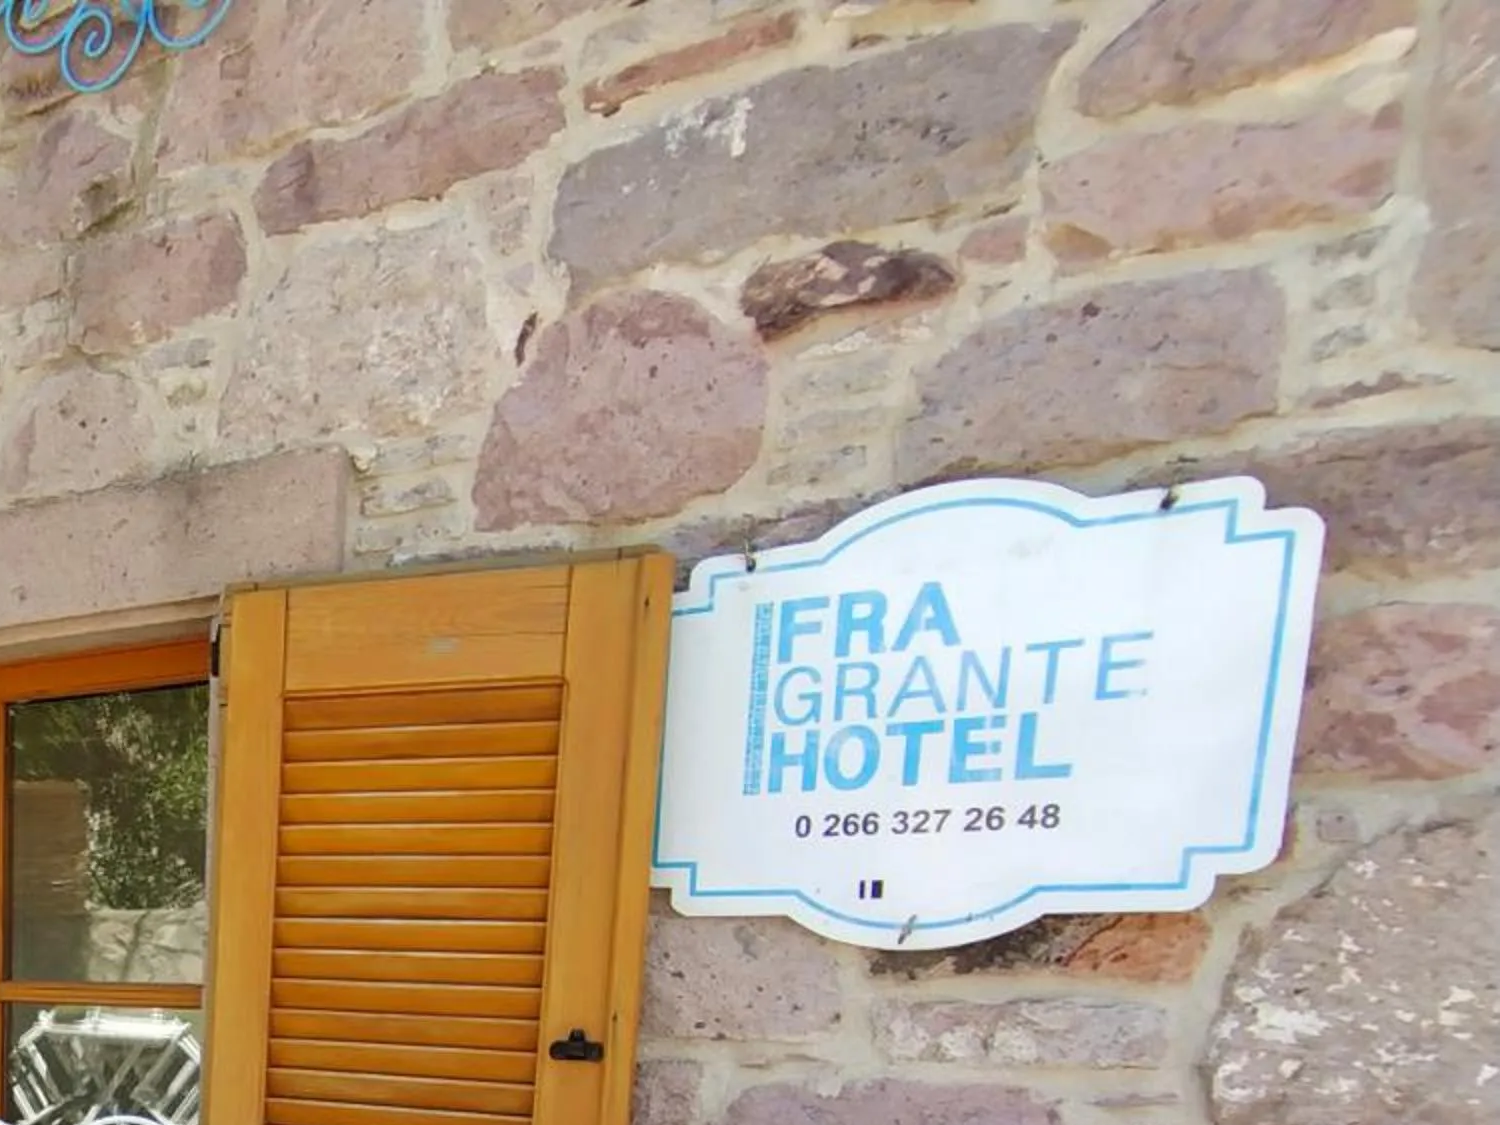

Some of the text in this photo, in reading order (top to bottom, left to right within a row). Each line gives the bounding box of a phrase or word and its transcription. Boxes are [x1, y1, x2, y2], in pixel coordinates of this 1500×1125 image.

[777, 582, 959, 664] FRA
[773, 631, 1154, 727] GRANTE
[768, 712, 1072, 793] HOTEL
[794, 804, 1061, 838] 0 266 327 26 48
